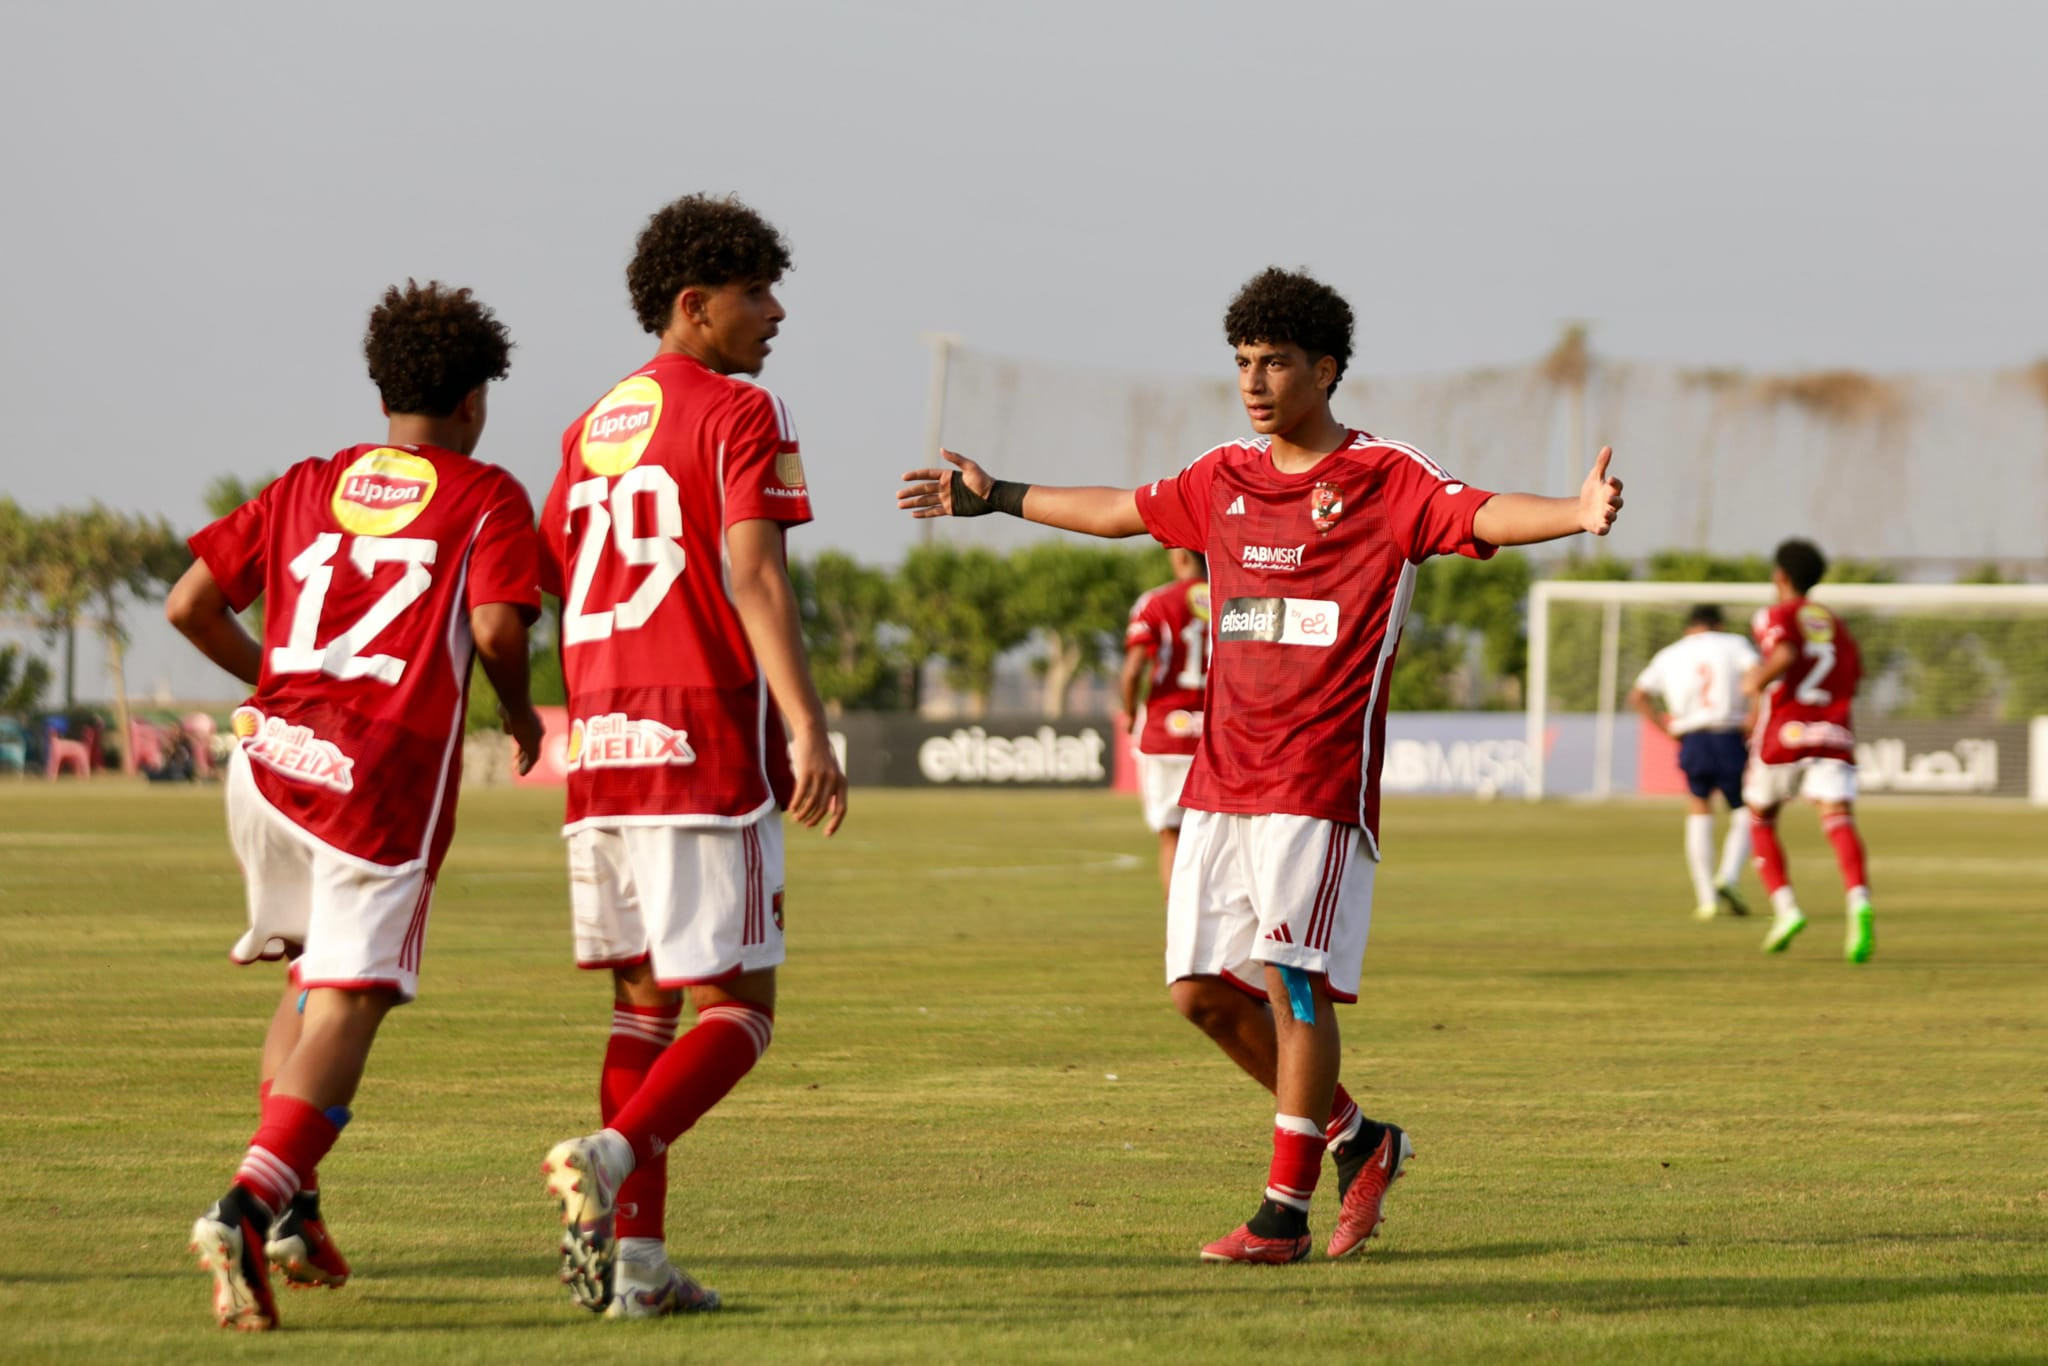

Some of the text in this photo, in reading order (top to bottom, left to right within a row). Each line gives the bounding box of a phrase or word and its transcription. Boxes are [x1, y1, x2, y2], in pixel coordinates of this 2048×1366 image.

[590, 411, 650, 438] Lipton
[347, 478, 420, 503] Lipton
[763, 487, 808, 497] ALMARA
[563, 465, 686, 648] 29
[1242, 545, 1297, 564] FABMISR
[271, 532, 437, 686] 12
[1221, 608, 1276, 632] etisalat
[1796, 642, 1836, 706] 2
[589, 732, 686, 761] HELIX
[919, 726, 1105, 782] etisalat
